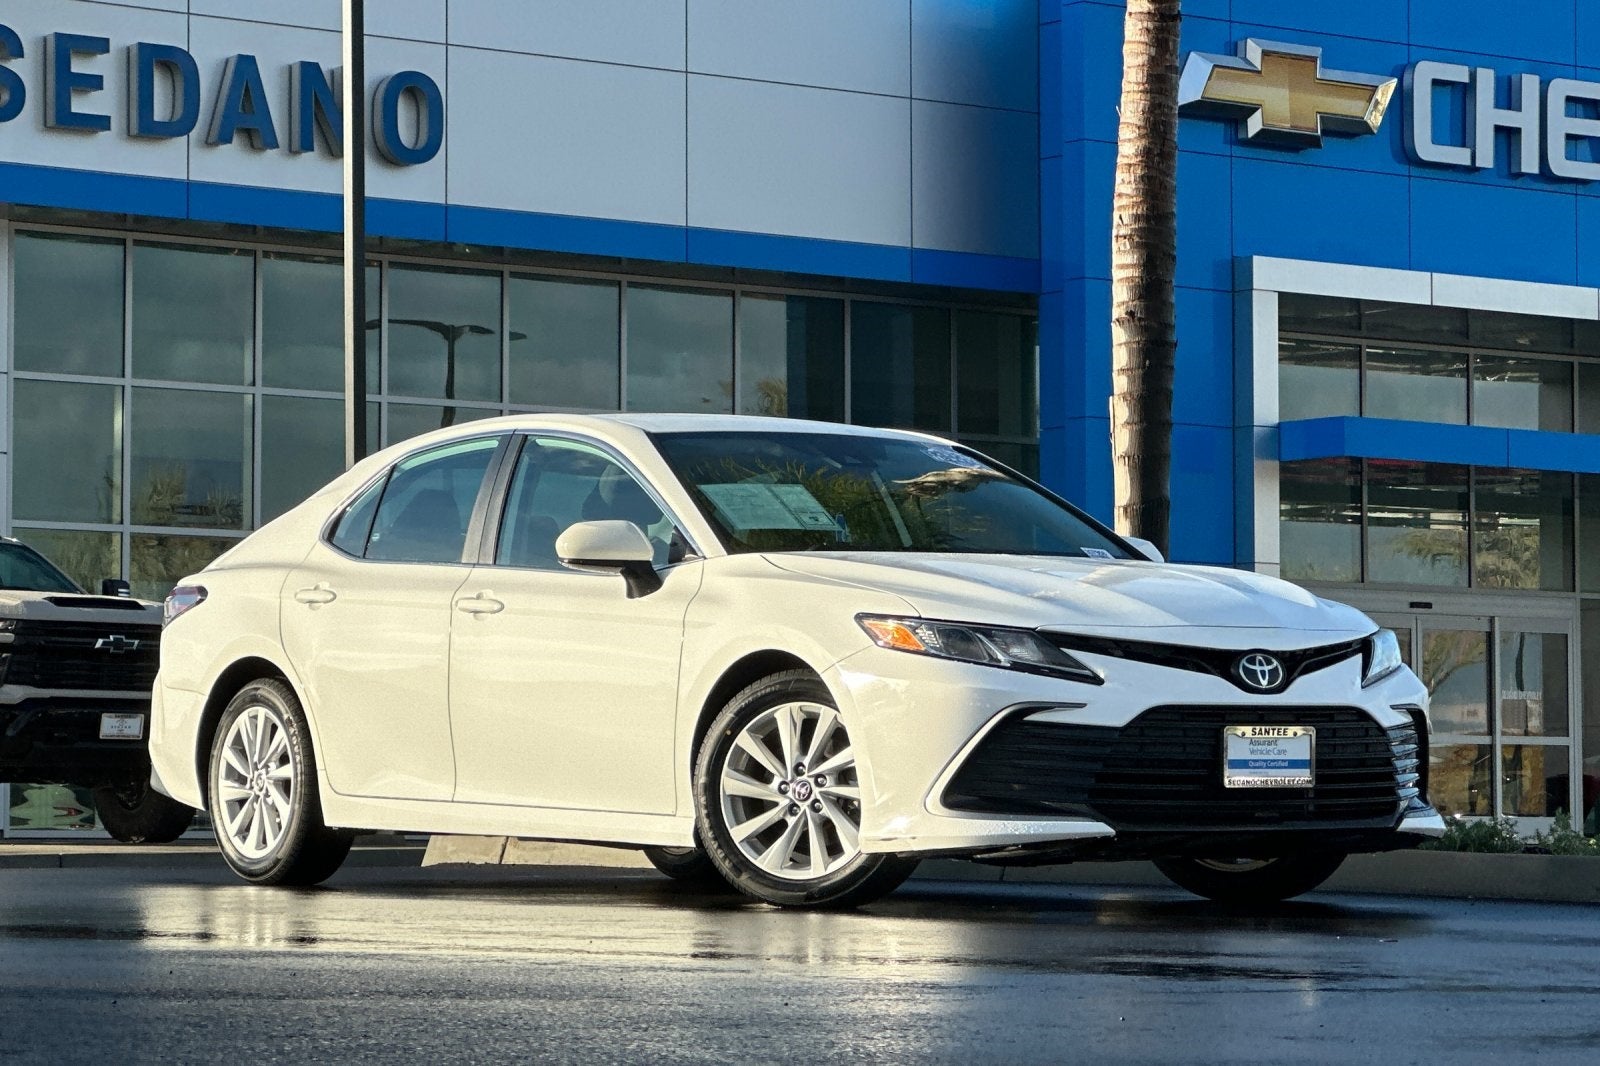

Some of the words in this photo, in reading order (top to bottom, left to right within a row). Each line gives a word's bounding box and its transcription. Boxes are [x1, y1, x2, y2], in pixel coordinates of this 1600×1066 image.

[1251, 728, 1288, 736] SANTEE
[1249, 738, 1278, 746] Assurant
[1249, 747, 1272, 756] Vehicle
[1272, 747, 1287, 756] Care
[1248, 760, 1266, 769] Quality
[1267, 760, 1289, 768] Certified
